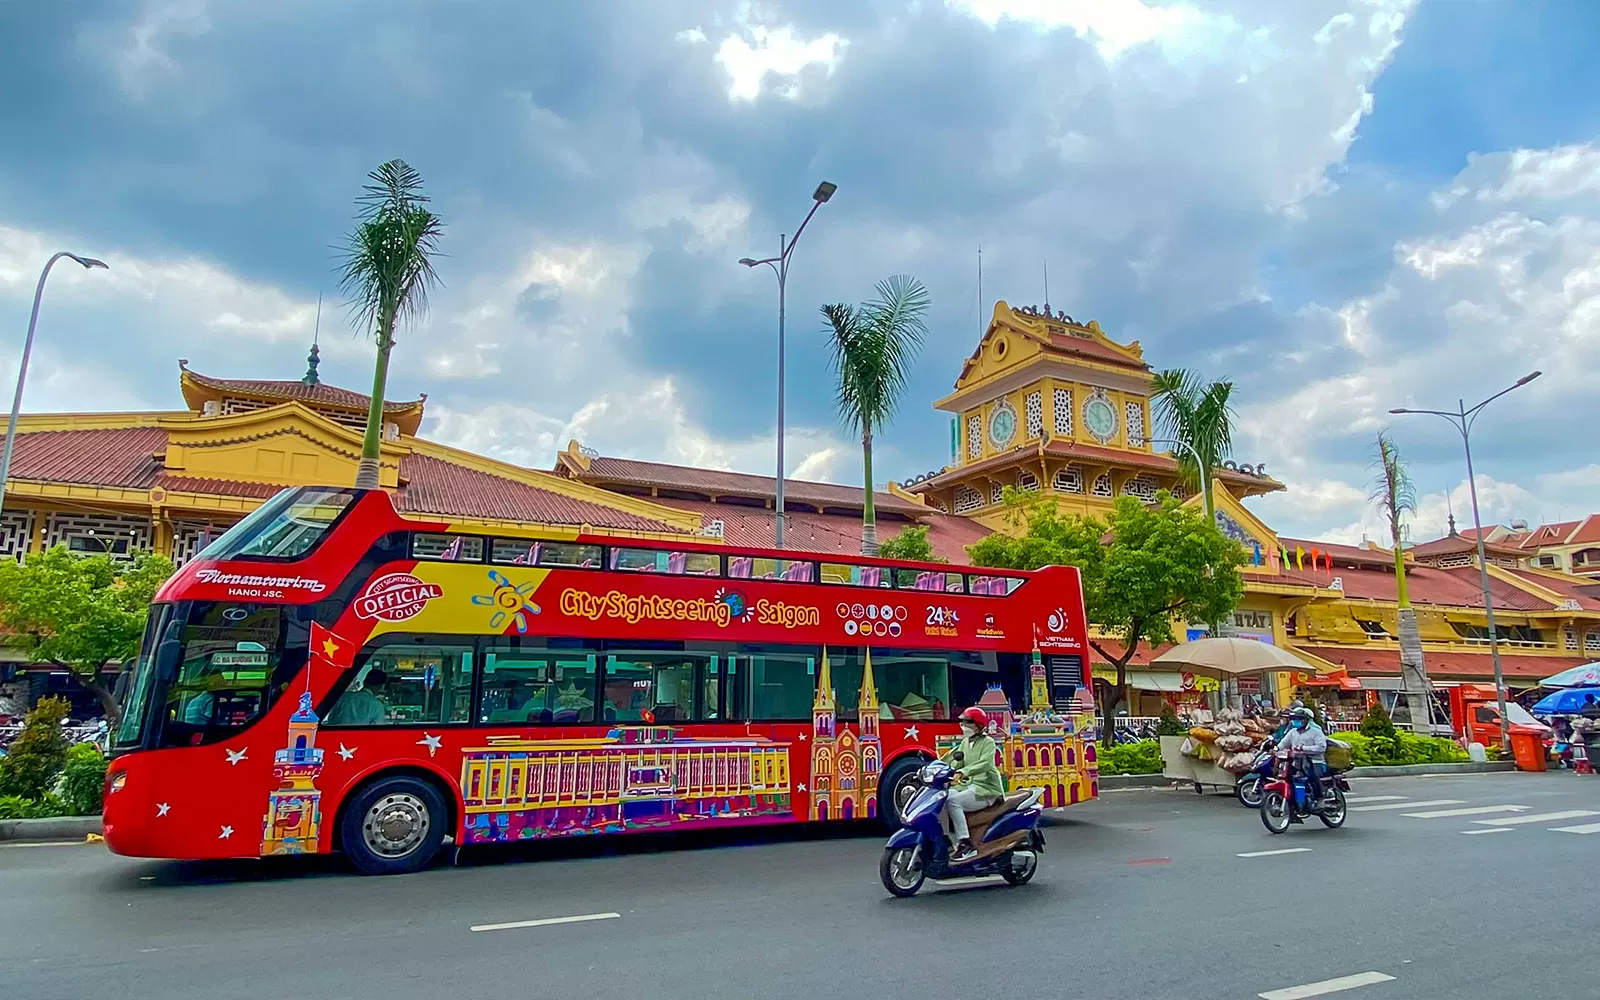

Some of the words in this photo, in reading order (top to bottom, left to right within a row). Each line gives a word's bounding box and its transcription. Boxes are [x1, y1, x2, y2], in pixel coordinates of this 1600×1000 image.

[228, 588, 261, 597] HANOI
[364, 586, 440, 613] OFFICIAL
[389, 603, 421, 618] TOUR
[757, 599, 819, 628] Saigon
[926, 605, 944, 625] 24
